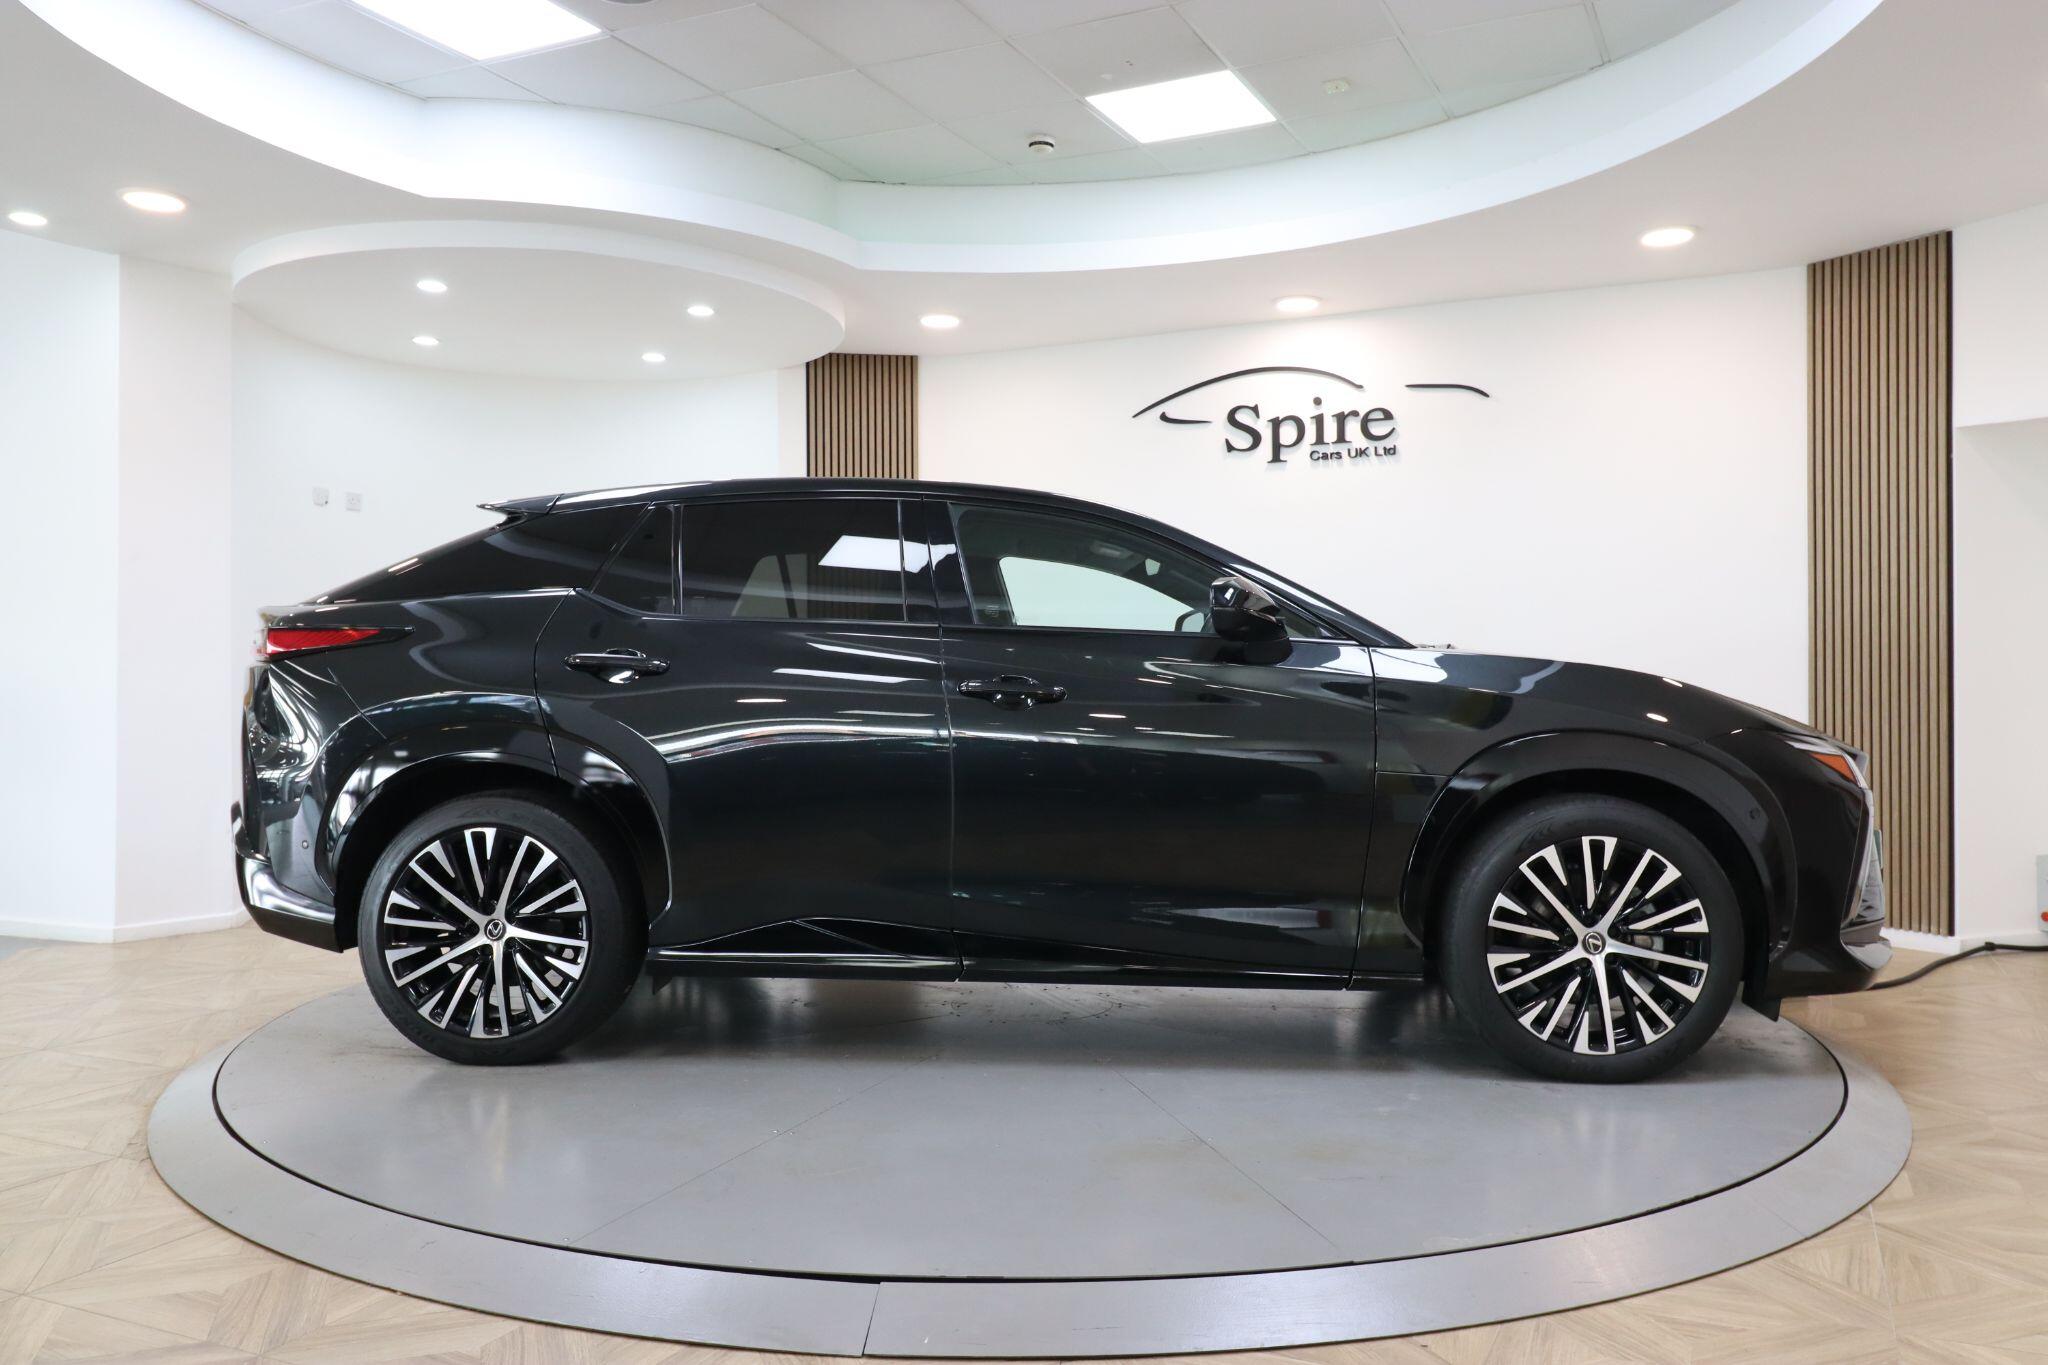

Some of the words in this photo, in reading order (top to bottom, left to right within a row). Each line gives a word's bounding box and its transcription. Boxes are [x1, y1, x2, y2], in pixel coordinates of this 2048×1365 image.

[1225, 396, 1396, 464] Spire
[1309, 450, 1343, 462] Cars
[1347, 446, 1370, 459] UK
[1374, 444, 1397, 457] Ltd
